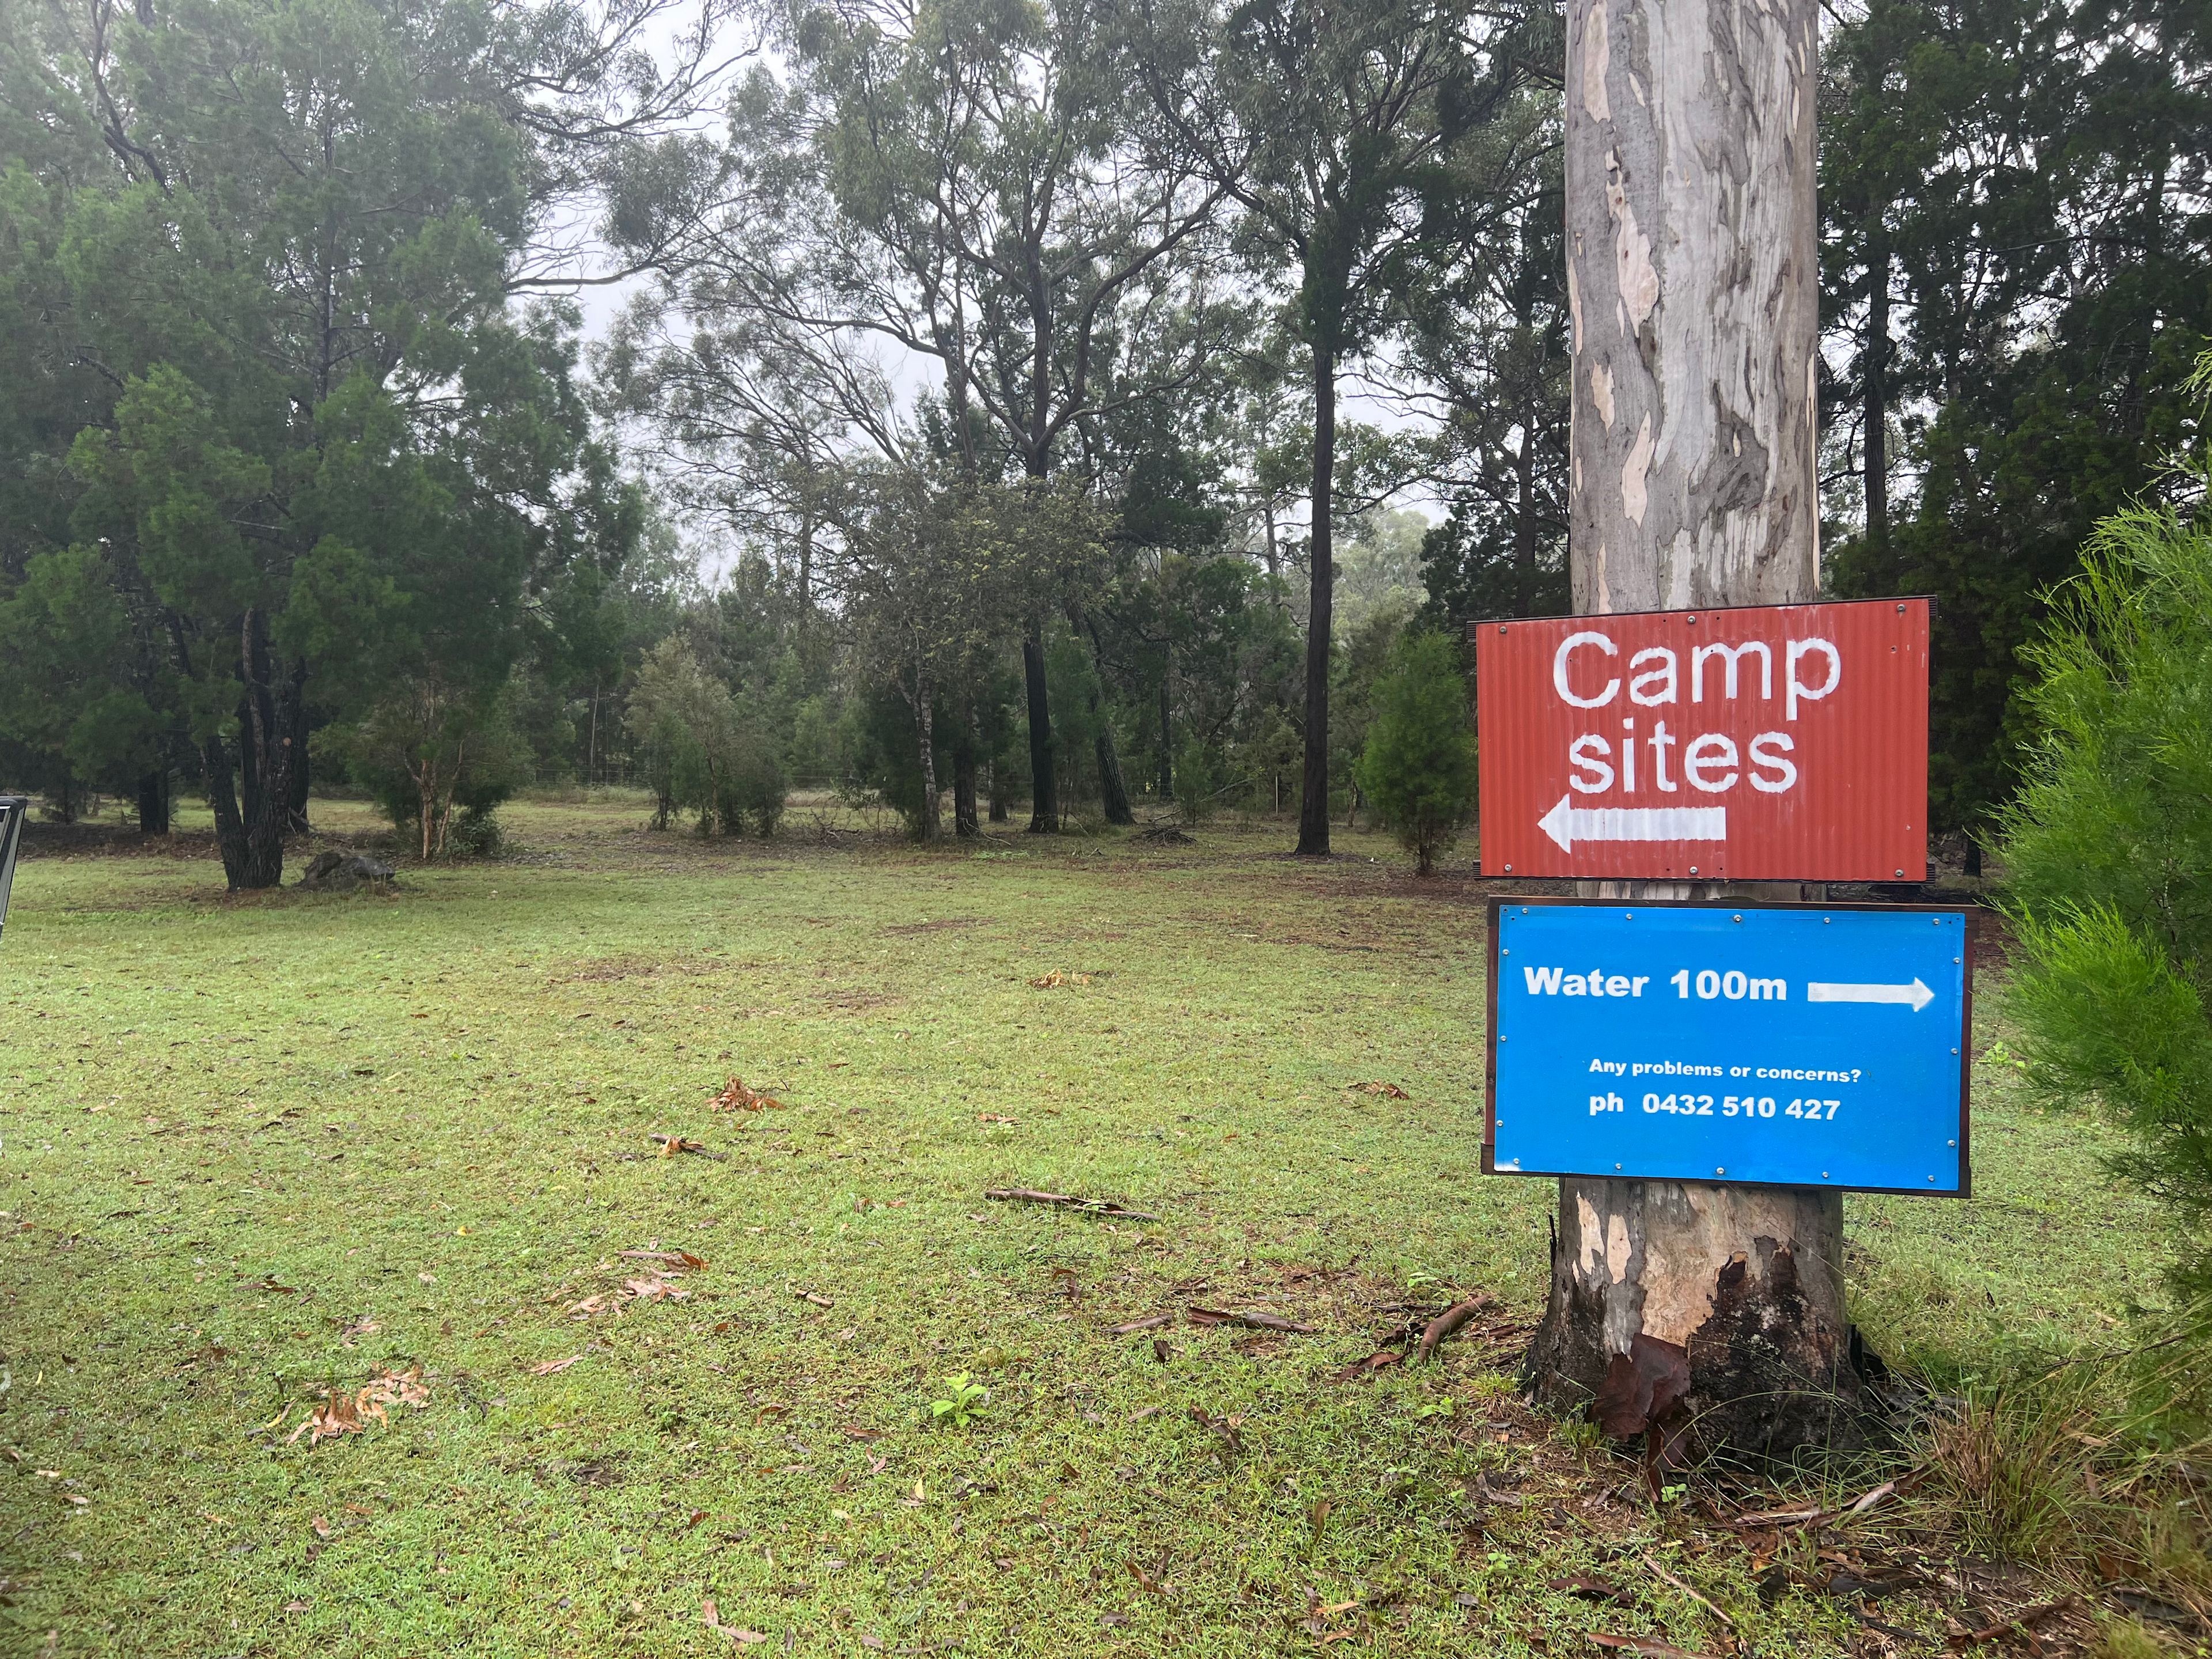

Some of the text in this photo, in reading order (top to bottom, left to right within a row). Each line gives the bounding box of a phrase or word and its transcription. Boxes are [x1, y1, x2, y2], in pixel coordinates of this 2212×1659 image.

[1552, 630, 1842, 721] Camp
[1569, 717, 1798, 794] sites
[1524, 967, 1787, 1001] Water 100m
[1589, 1058, 1862, 1083] Any problems or concerns?
[1589, 1092, 1841, 1120] ph 0432 510 427
